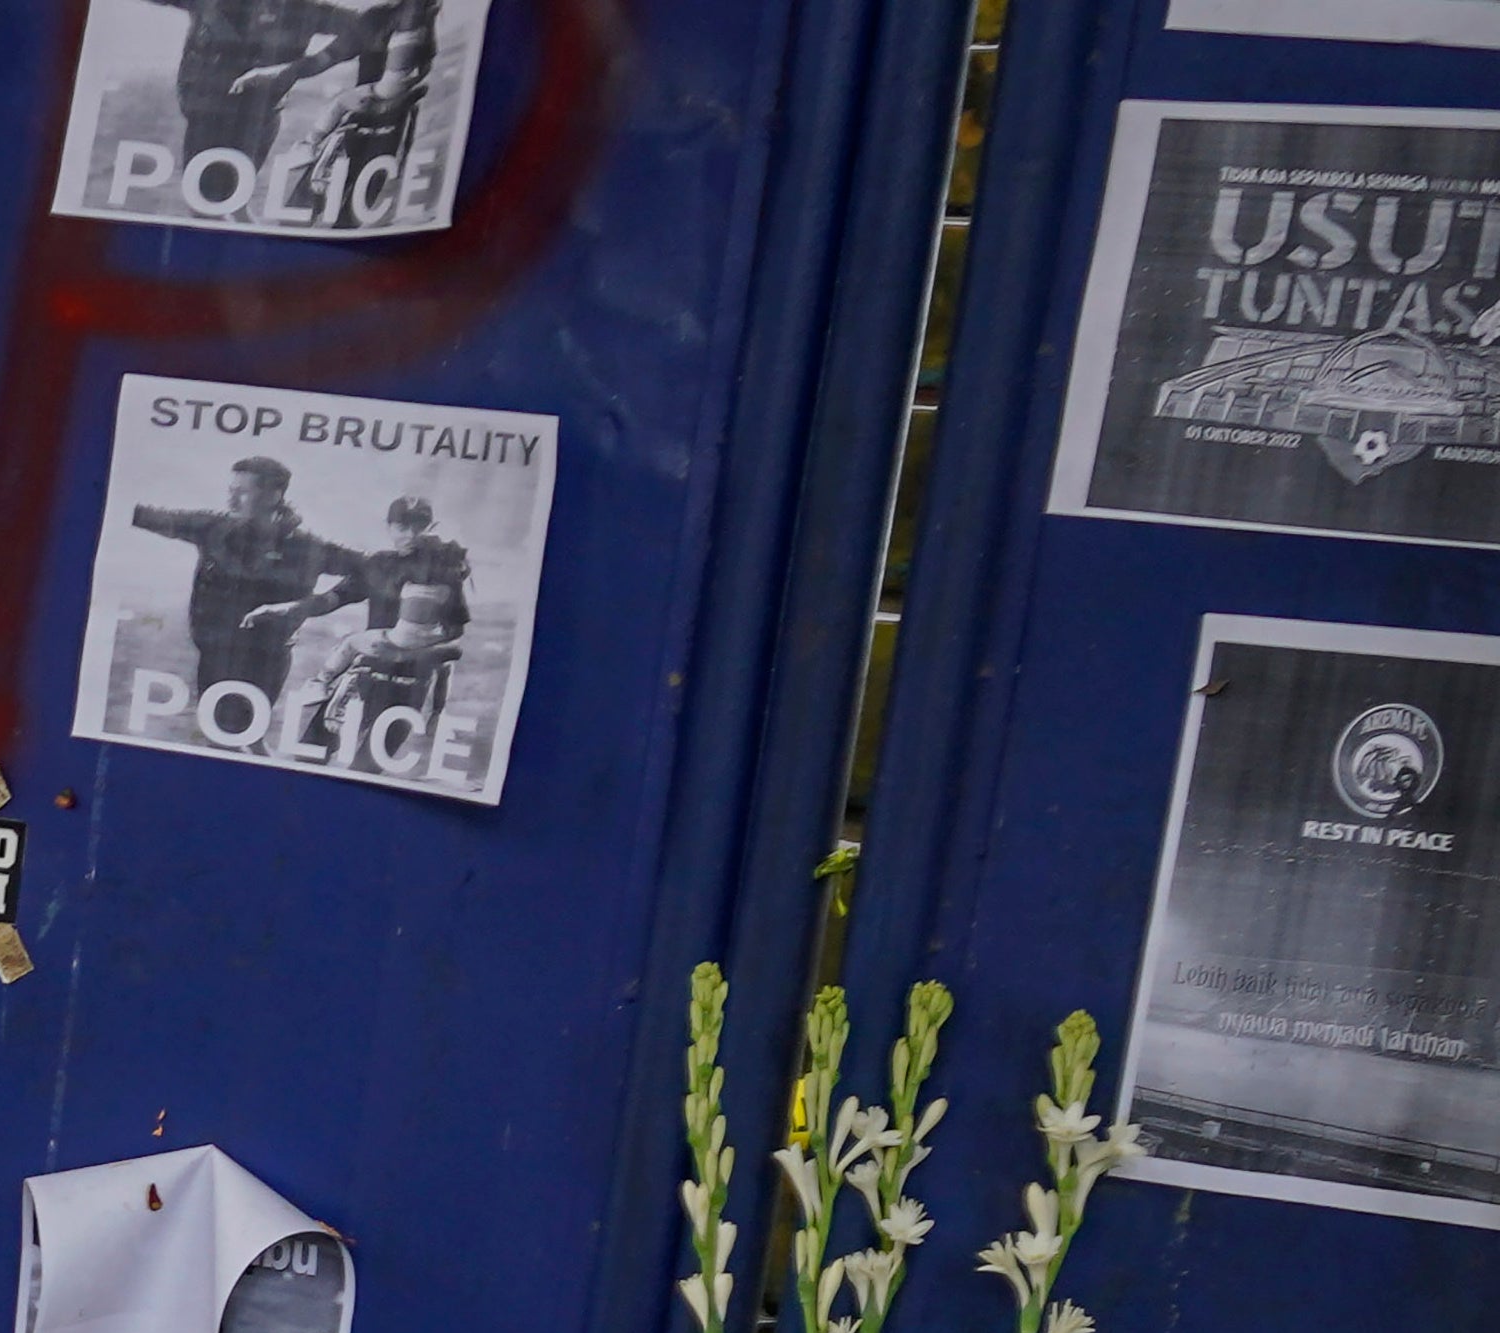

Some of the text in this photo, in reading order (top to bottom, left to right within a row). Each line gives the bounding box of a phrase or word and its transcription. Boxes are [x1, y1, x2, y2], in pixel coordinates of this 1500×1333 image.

[106, 140, 439, 224] POLICE
[1196, 267, 1482, 335] TUNTAS
[149, 396, 540, 467] STOP BRUTALITY
[125, 668, 479, 779] POLICE
[1302, 820, 1455, 852] REST IN PEACE
[1219, 1011, 1288, 1038] nyawa
[1292, 1020, 1376, 1048] menjadi
